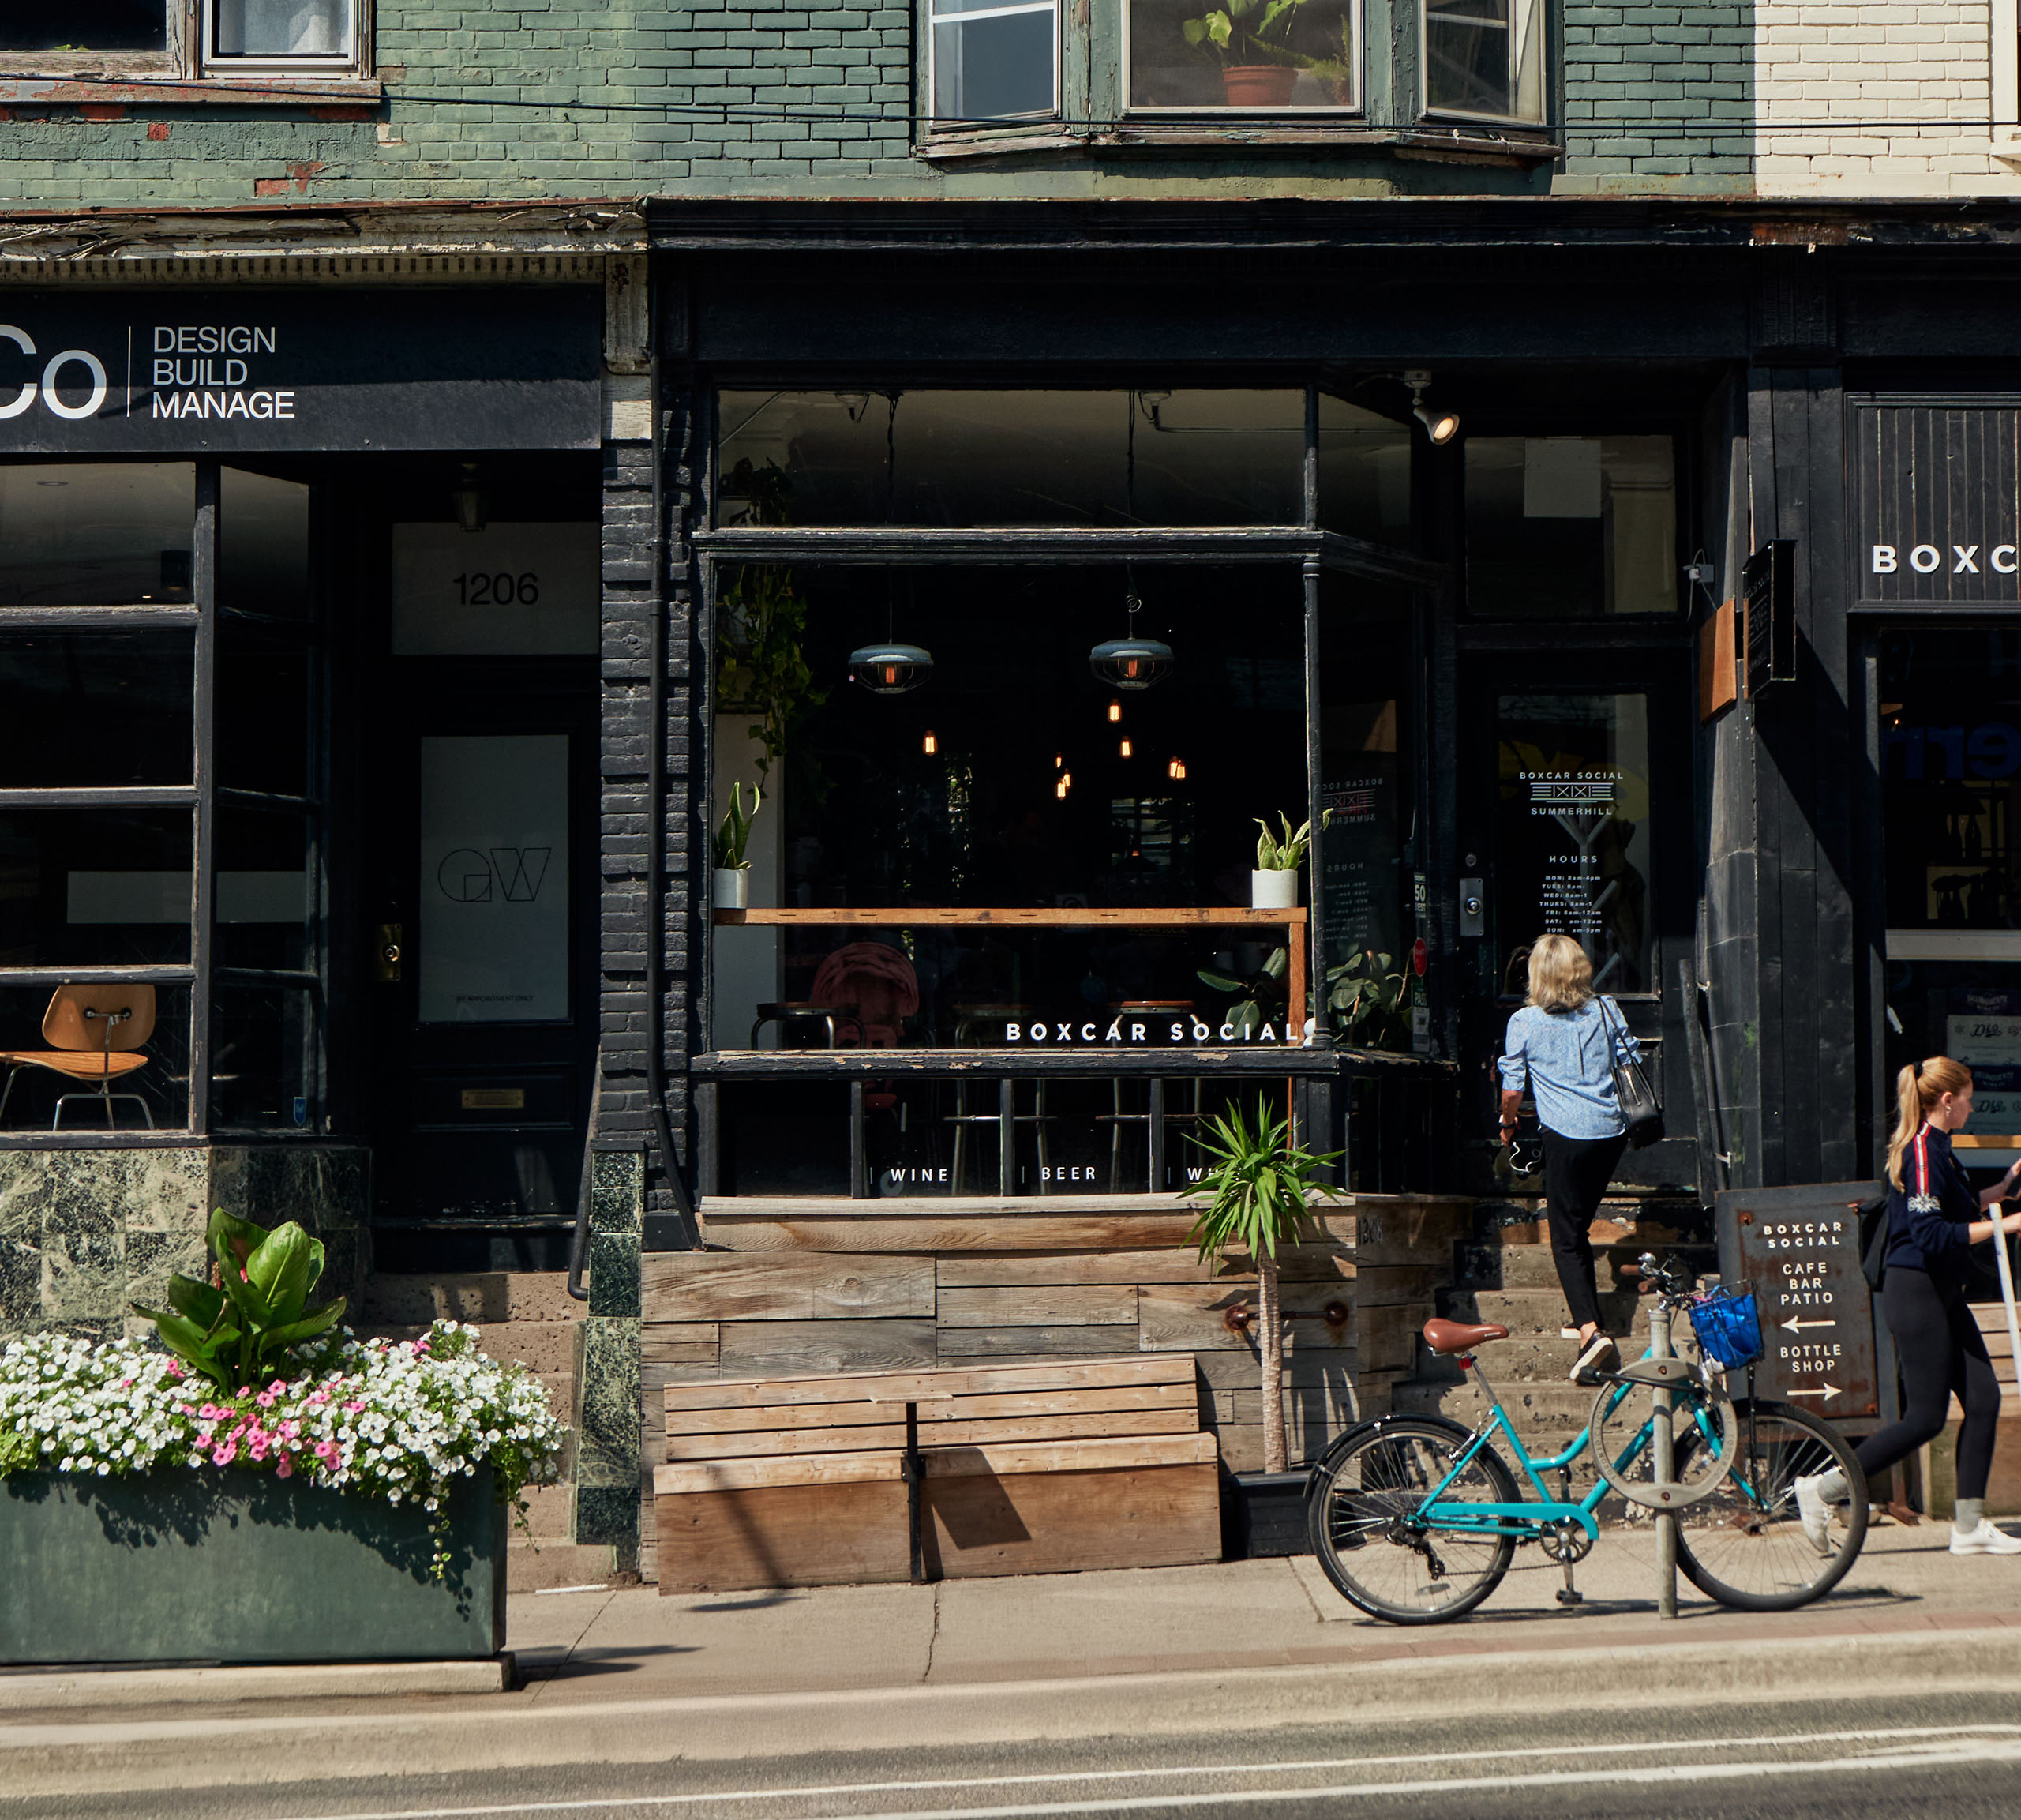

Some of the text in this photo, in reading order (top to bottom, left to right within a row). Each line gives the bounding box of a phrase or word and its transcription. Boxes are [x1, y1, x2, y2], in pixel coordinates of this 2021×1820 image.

[153, 326, 276, 354] DESIGN
[153, 358, 248, 386] BUILD
[152, 391, 295, 418] MANAGE
[1873, 544, 2018, 574] BOXC
[452, 572, 539, 606] 1206
[438, 847, 551, 902] GW
[1414, 884, 1426, 902] 50
[1006, 1022, 1299, 1041] BOXCAR SOCIAL
[891, 1167, 949, 1183] WINE
[1042, 1166, 1096, 1181] BEER
[1763, 1222, 1842, 1236] BOXCAR
[1768, 1236, 1840, 1249] SOCIAL
[1782, 1262, 1828, 1275] CAFE
[1789, 1278, 1823, 1290] BAR
[1780, 1291, 1834, 1306] PATIO
[1780, 1344, 1842, 1358] BOTTLE
[1792, 1359, 1835, 1373] SHOP
